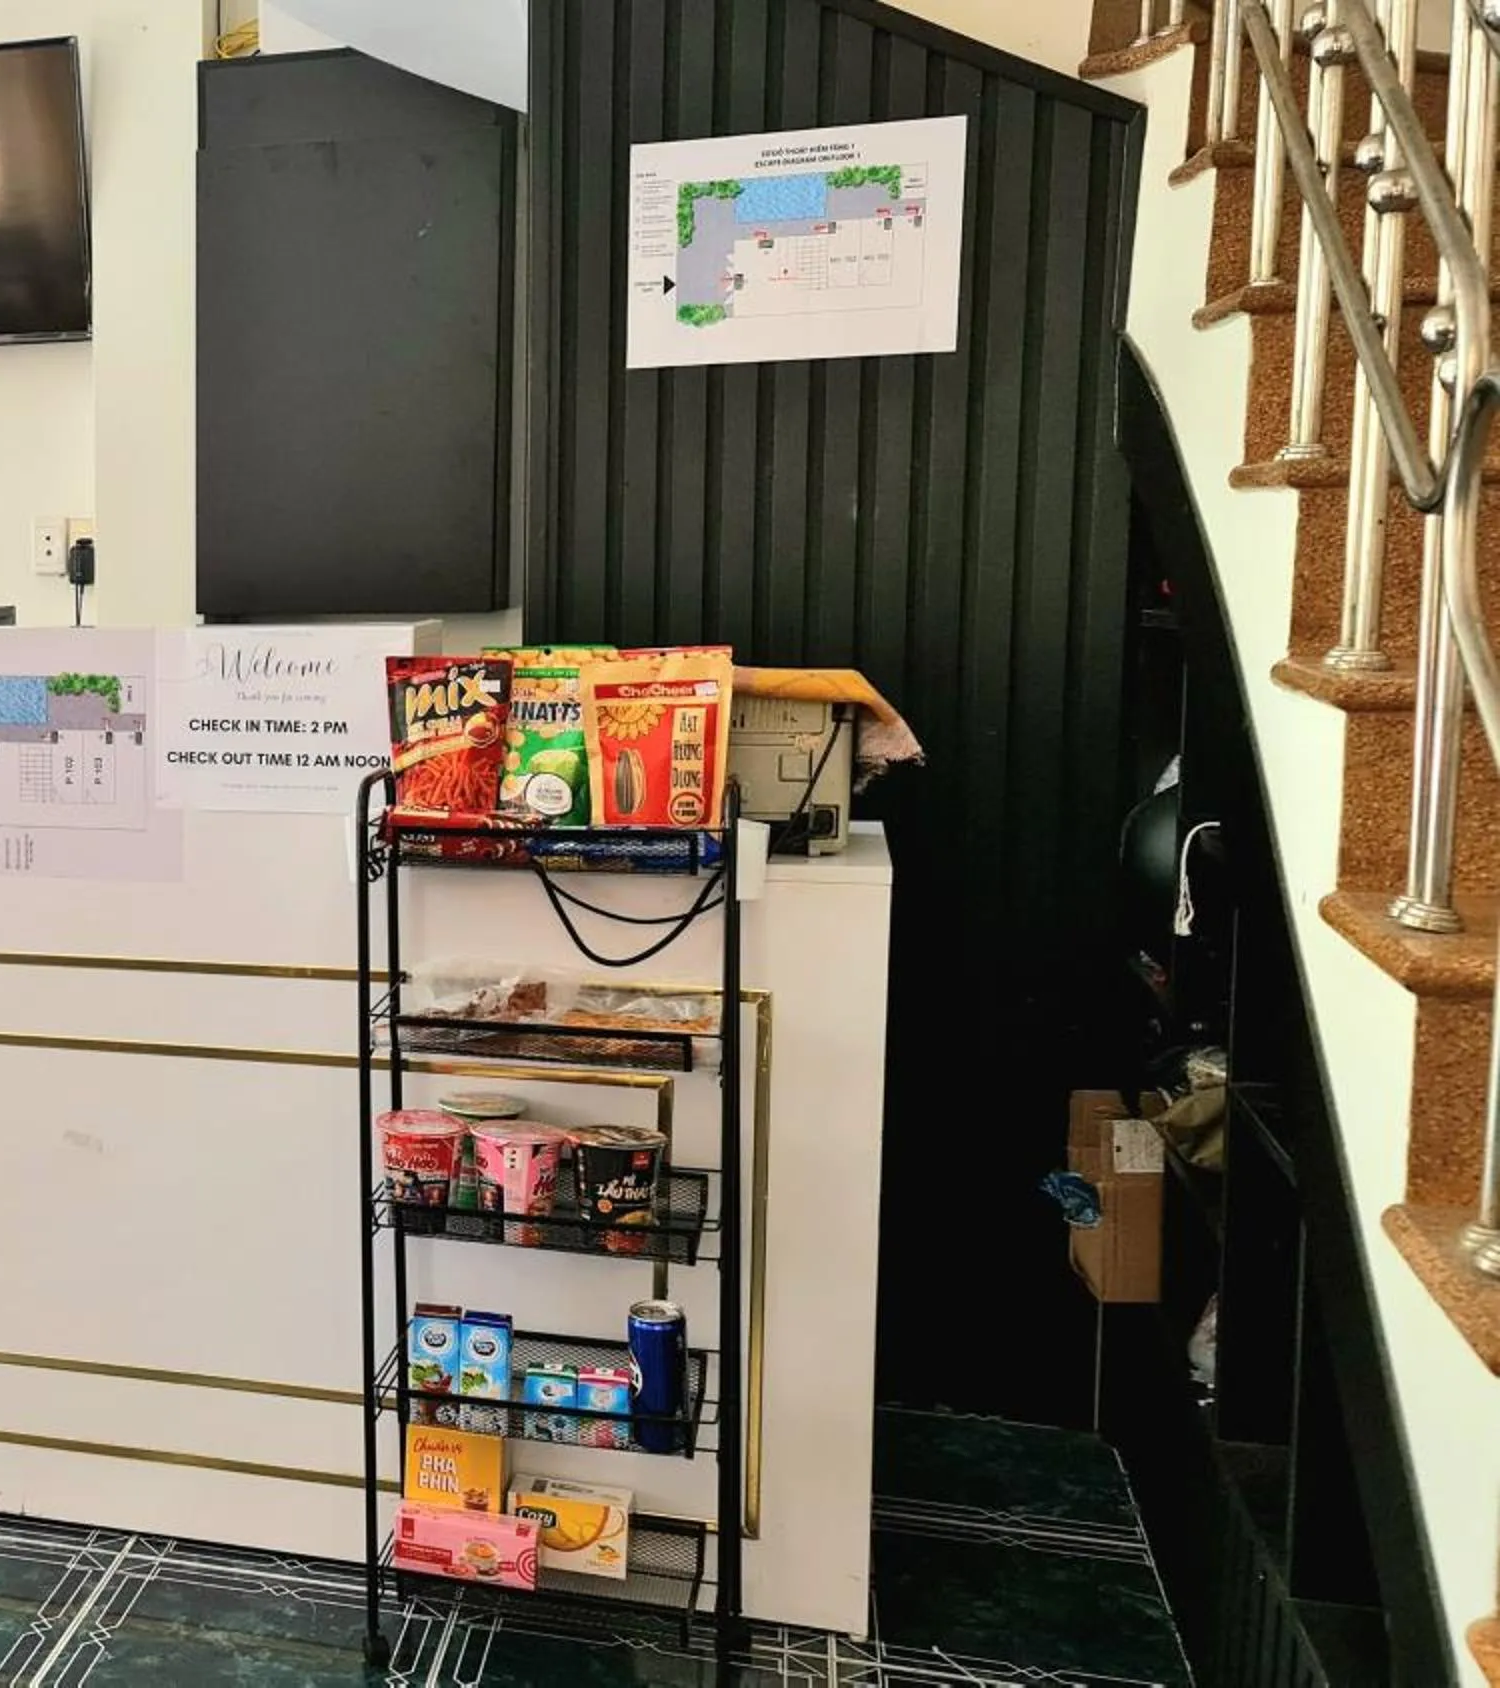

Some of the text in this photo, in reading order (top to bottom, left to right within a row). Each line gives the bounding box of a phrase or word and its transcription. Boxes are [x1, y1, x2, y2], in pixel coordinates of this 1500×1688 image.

[204, 641, 338, 683] Welcome
[189, 719, 348, 735] CHECK IN TIME: 2 PM
[167, 751, 390, 768] CHECK OUT TIME 12 AM NOON
[422, 1454, 456, 1474] PHA
